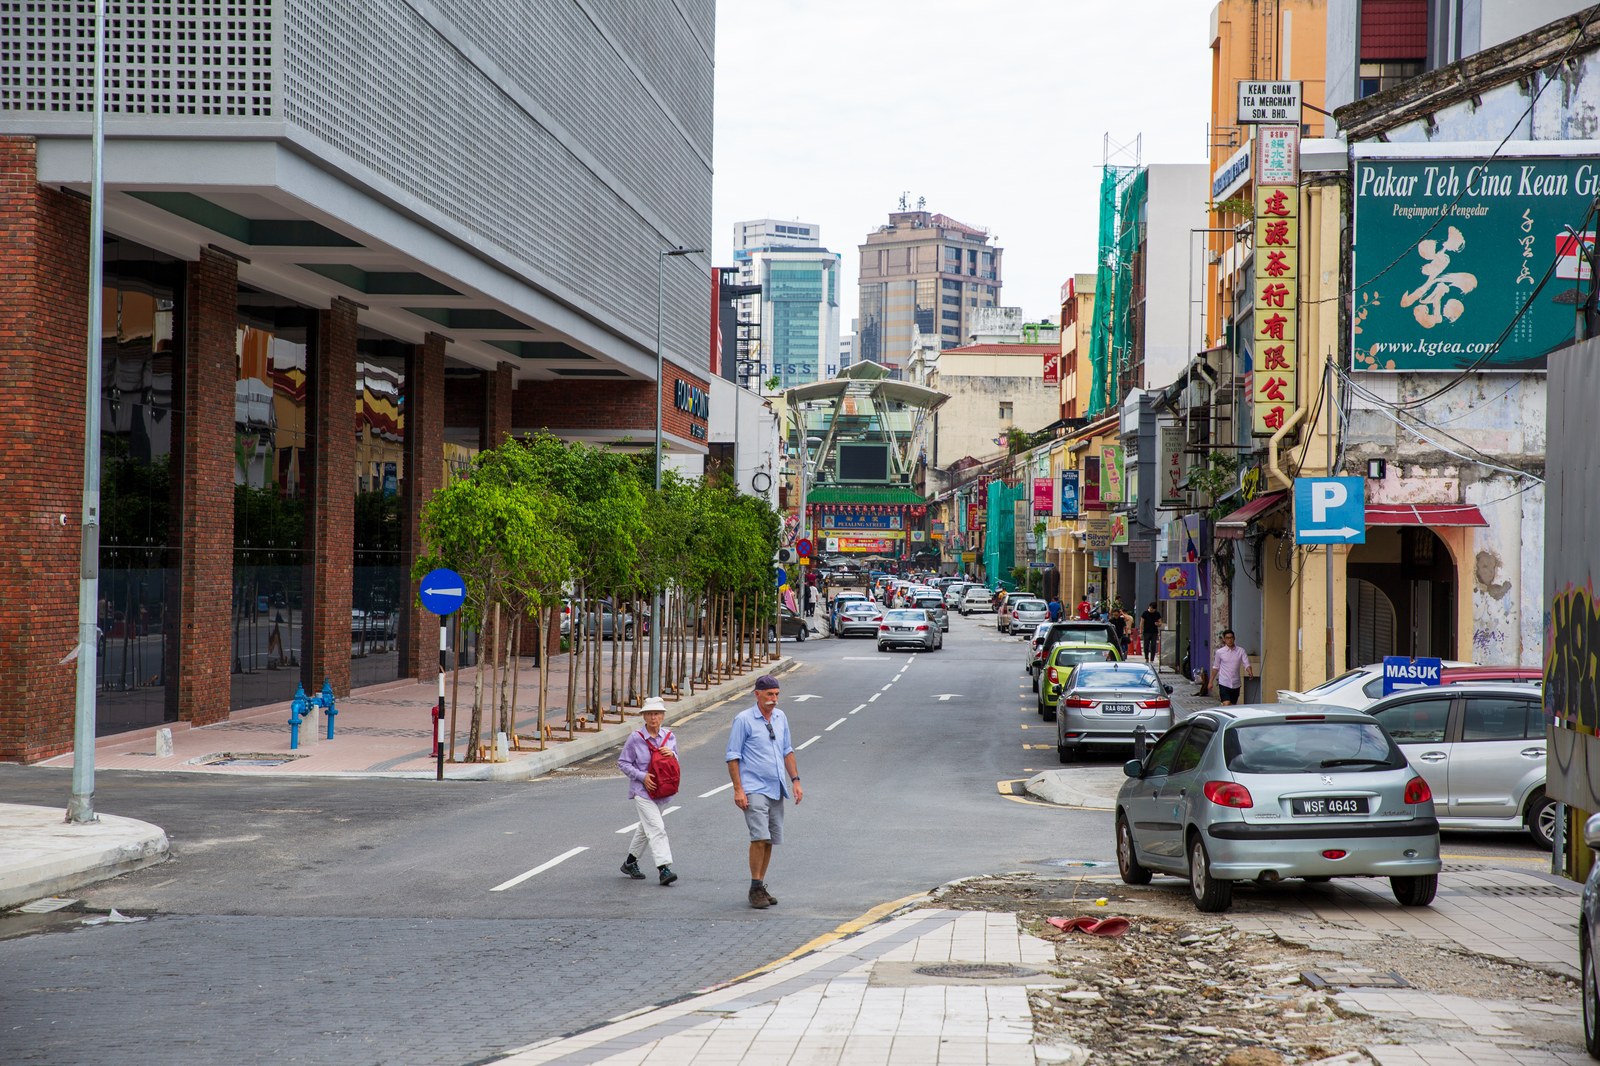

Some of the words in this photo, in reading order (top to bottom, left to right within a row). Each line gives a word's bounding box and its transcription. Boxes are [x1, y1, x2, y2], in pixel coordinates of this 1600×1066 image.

[1248, 84, 1267, 95] KEAN
[1272, 84, 1291, 95] GUAN
[1243, 96, 1255, 107] TEA
[1259, 96, 1296, 107] MERCHANT
[1252, 108, 1268, 119] SDN.
[1271, 108, 1288, 119] BHD.
[1359, 166, 1418, 197] Pakar
[1424, 166, 1459, 197] Teh
[1466, 165, 1512, 197] Cina
[1517, 165, 1568, 196] Kean
[1393, 203, 1440, 219] Pengimport
[1441, 204, 1449, 216] &
[1450, 203, 1489, 219] Pengedar
[1260, 189, 1291, 430] 建源茶行有限公司
[1375, 338, 1500, 356] www.kgtea.com
[1312, 482, 1348, 523] P
[1386, 664, 1439, 679] MASUK
[1303, 800, 1325, 812] WSF
[1328, 800, 1358, 812] 4643
